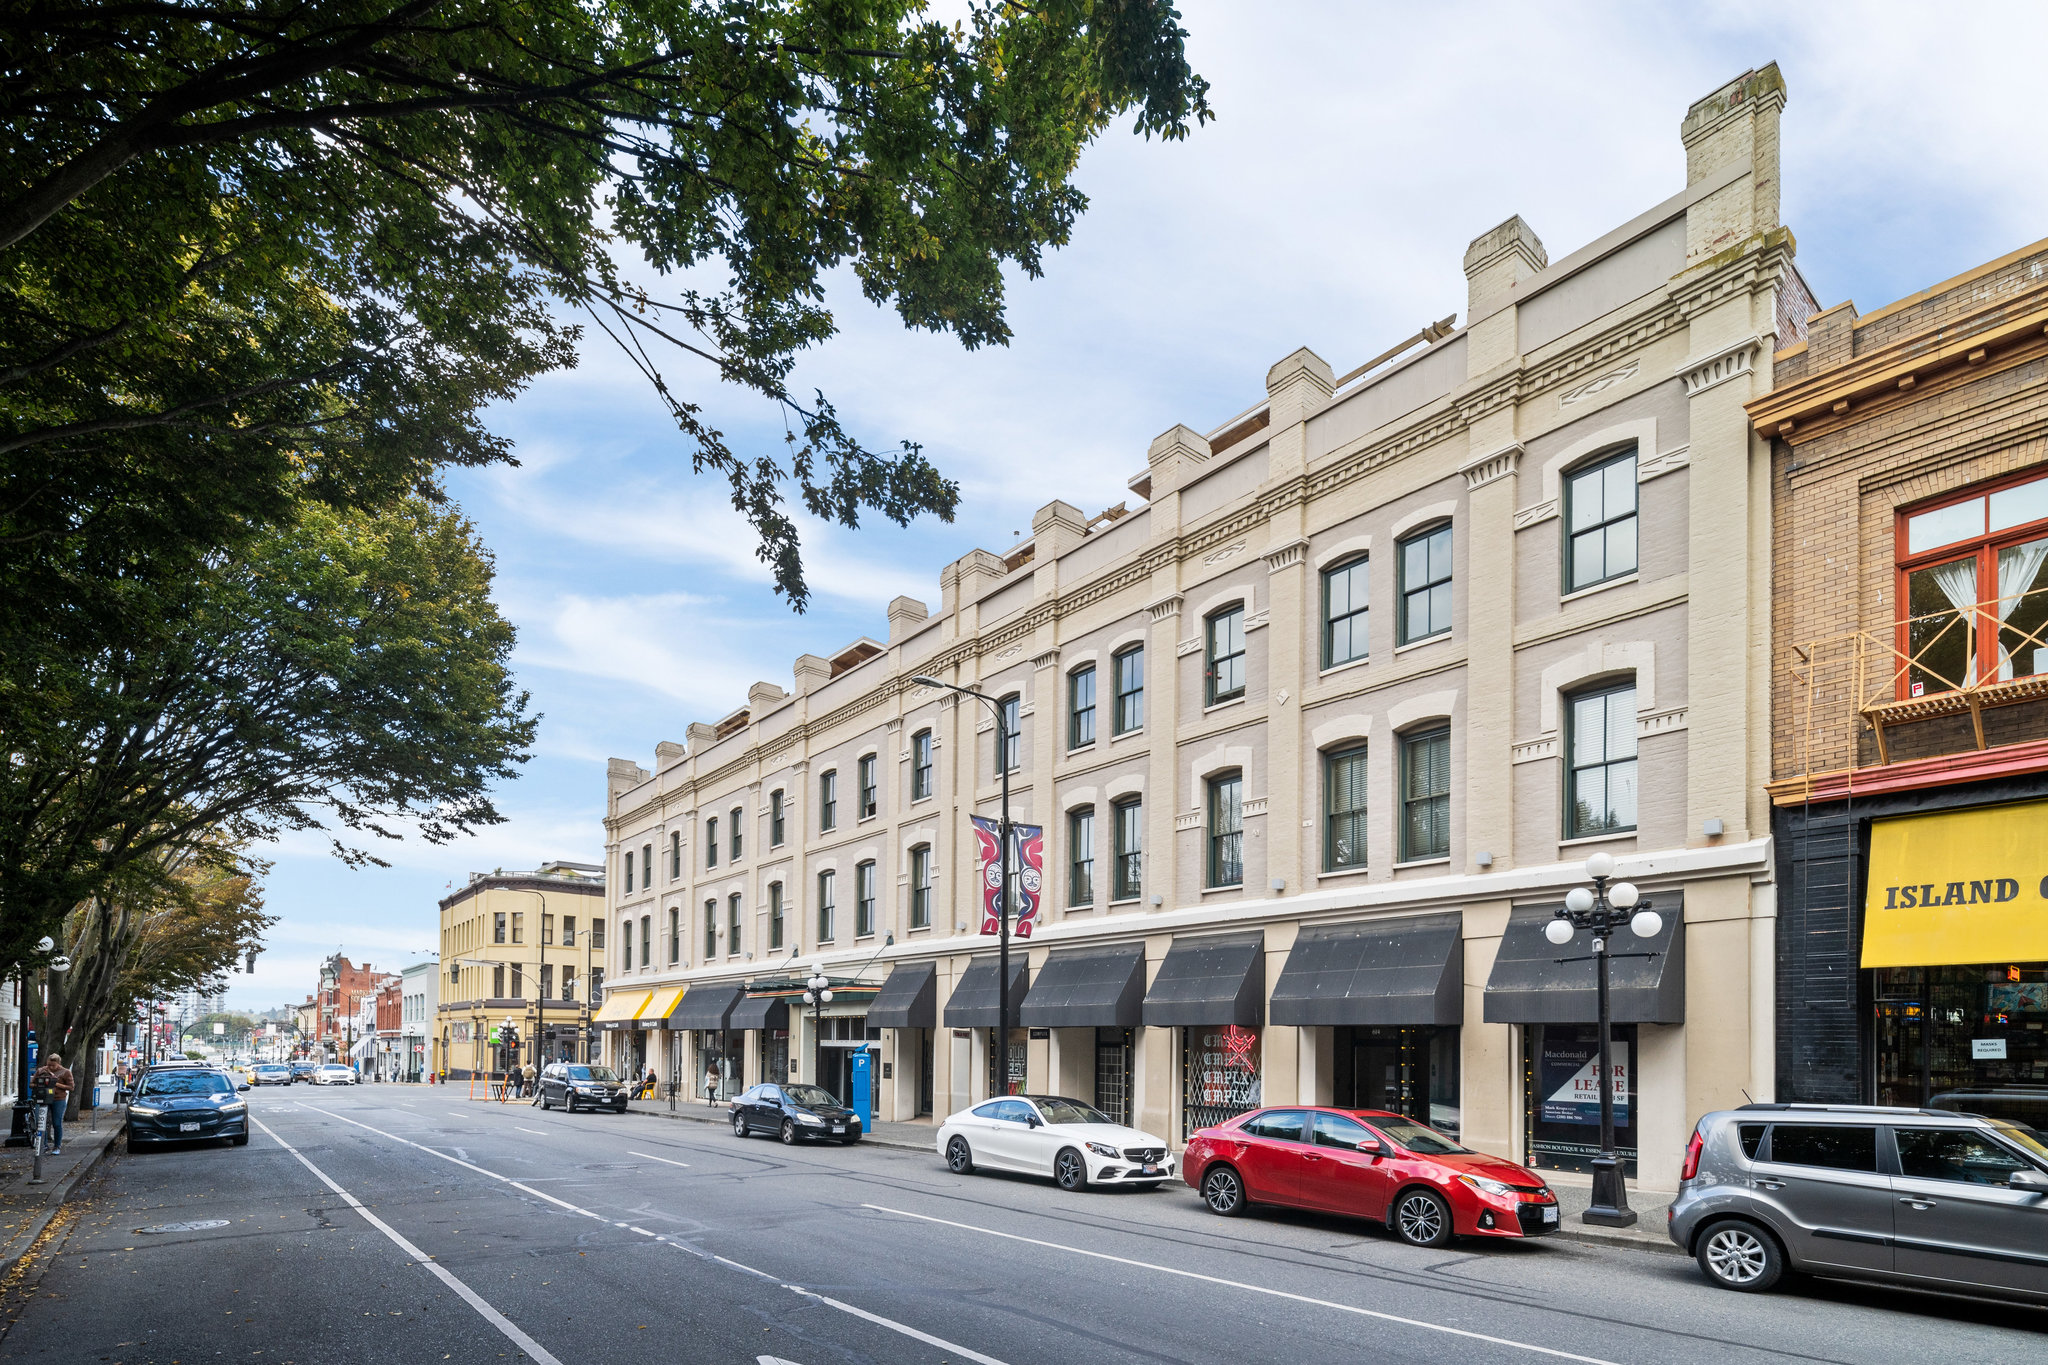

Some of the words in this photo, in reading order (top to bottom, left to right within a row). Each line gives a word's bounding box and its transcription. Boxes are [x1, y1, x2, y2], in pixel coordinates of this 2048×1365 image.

[1884, 878, 2020, 910] ISLAND
[1544, 1050, 1587, 1059] Macdonald
[858, 1059, 865, 1067] P
[1592, 1065, 1625, 1077] FR
[1574, 1079, 1625, 1092] LEAE
[1203, 1089, 1249, 1104] CMPLX
